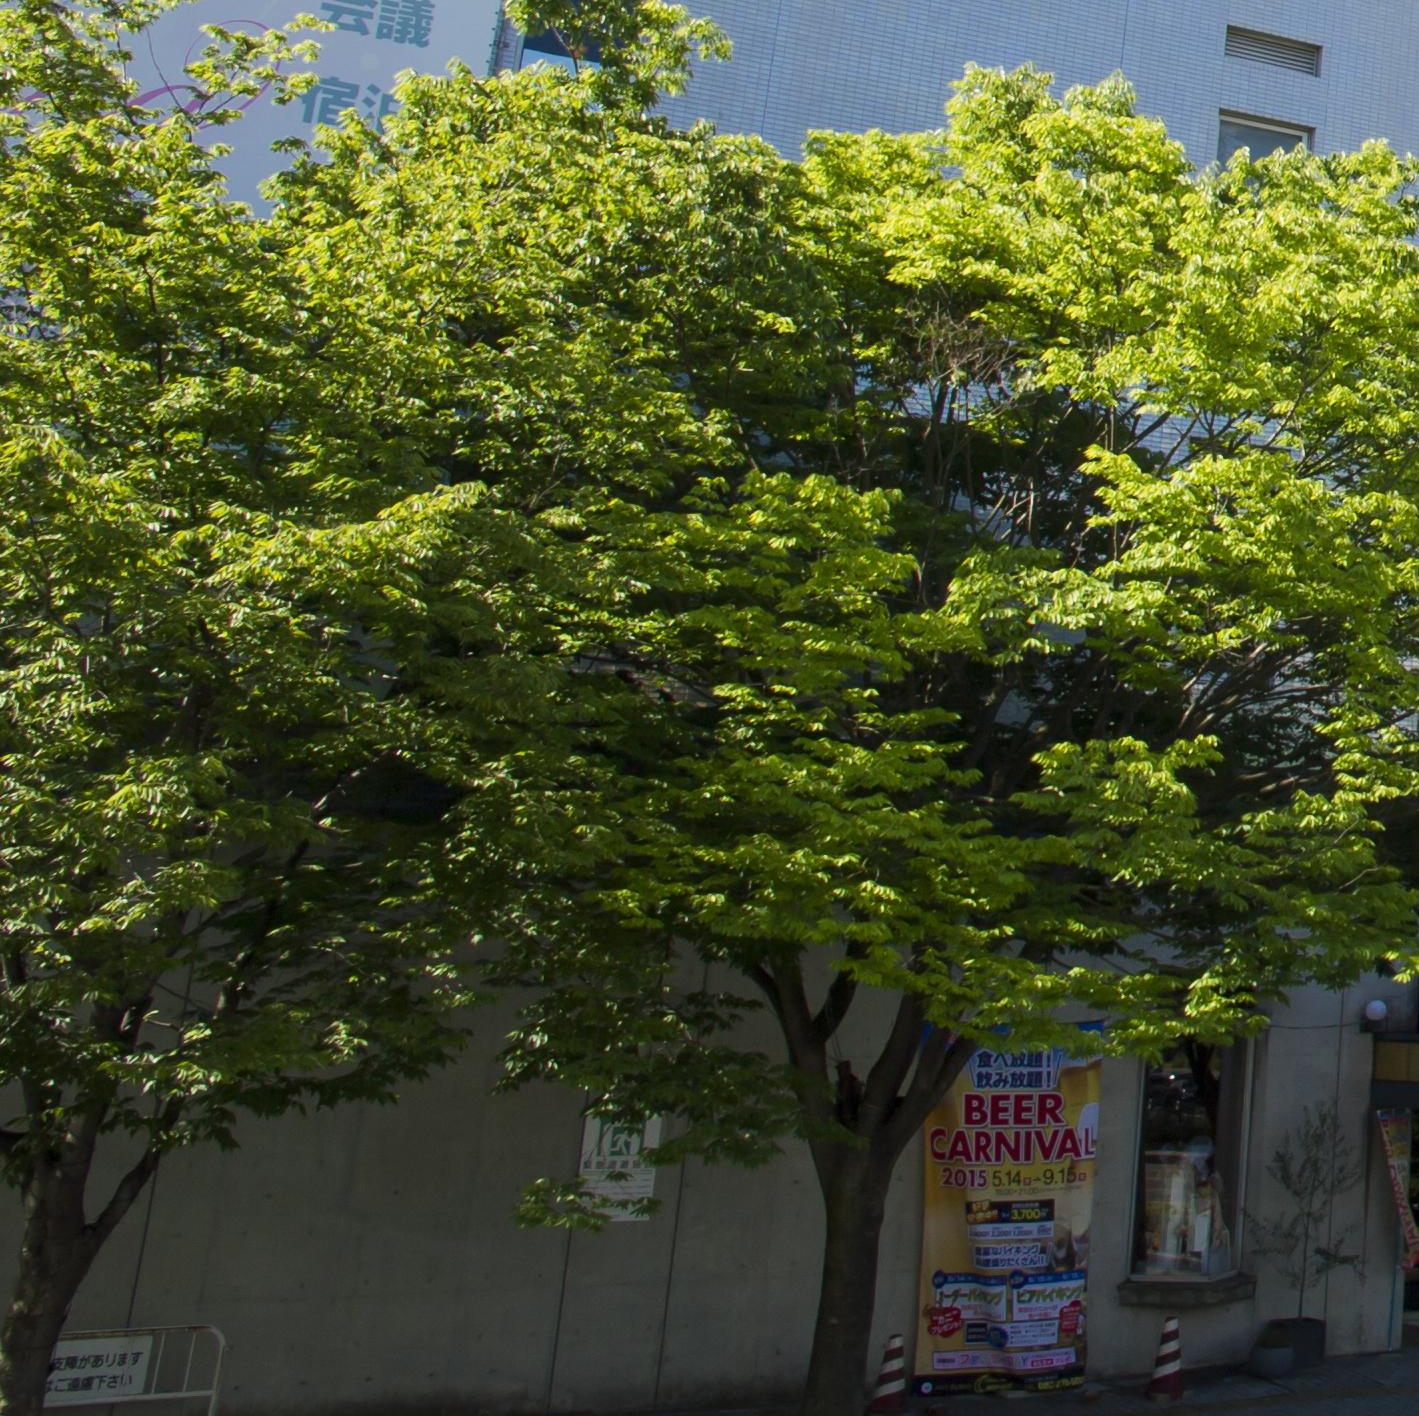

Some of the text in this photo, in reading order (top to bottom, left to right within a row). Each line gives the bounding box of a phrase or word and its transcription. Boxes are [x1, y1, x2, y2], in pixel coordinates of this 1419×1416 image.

[964, 1093, 1064, 1125] BEER
[930, 1127, 1096, 1162] CARNIVAL
[941, 1167, 987, 1187] 2015
